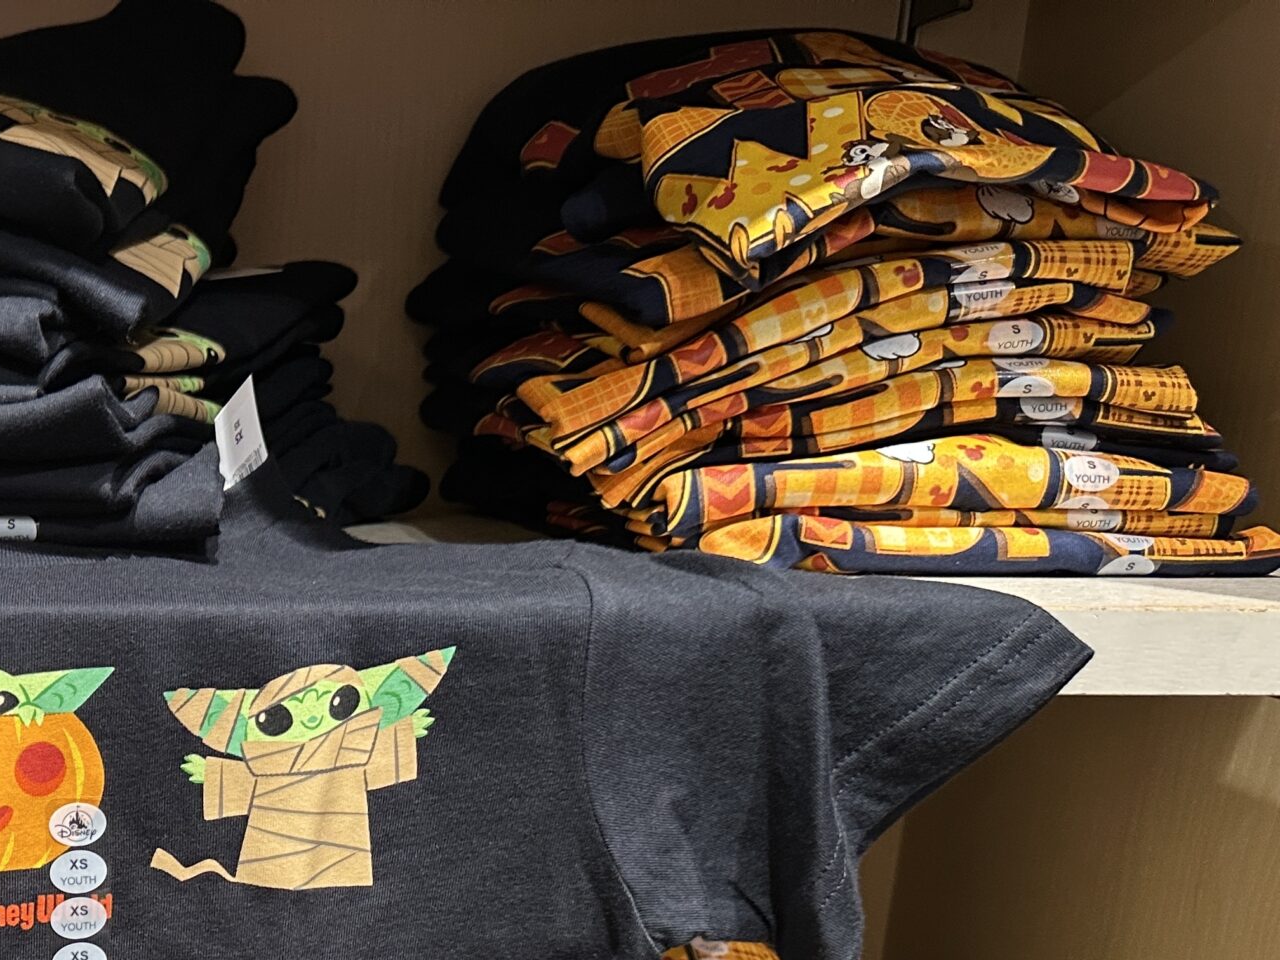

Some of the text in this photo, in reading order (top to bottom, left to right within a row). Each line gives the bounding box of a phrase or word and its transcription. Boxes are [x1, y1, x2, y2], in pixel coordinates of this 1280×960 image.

[1104, 226, 1138, 237] YOUTH
[961, 244, 1000, 254] YOUTH
[978, 270, 988, 279] S
[965, 289, 1003, 301] YOUTH
[1012, 324, 1021, 334] S
[997, 339, 1034, 349] YOUTH
[1022, 384, 1032, 394] S
[1031, 402, 1068, 413] YOUTH
[1050, 440, 1085, 450] YOUTH
[1087, 461, 1097, 469] S
[1074, 474, 1110, 484] YOUTH
[7, 519, 16, 530] S
[1076, 520, 1111, 528] YOUTH
[1125, 562, 1135, 571] S
[54, 824, 97, 840] Disney
[70, 859, 88, 870] XS
[60, 875, 97, 886] YOUTH
[70, 906, 88, 917] XS
[61, 921, 97, 932] YOUTH
